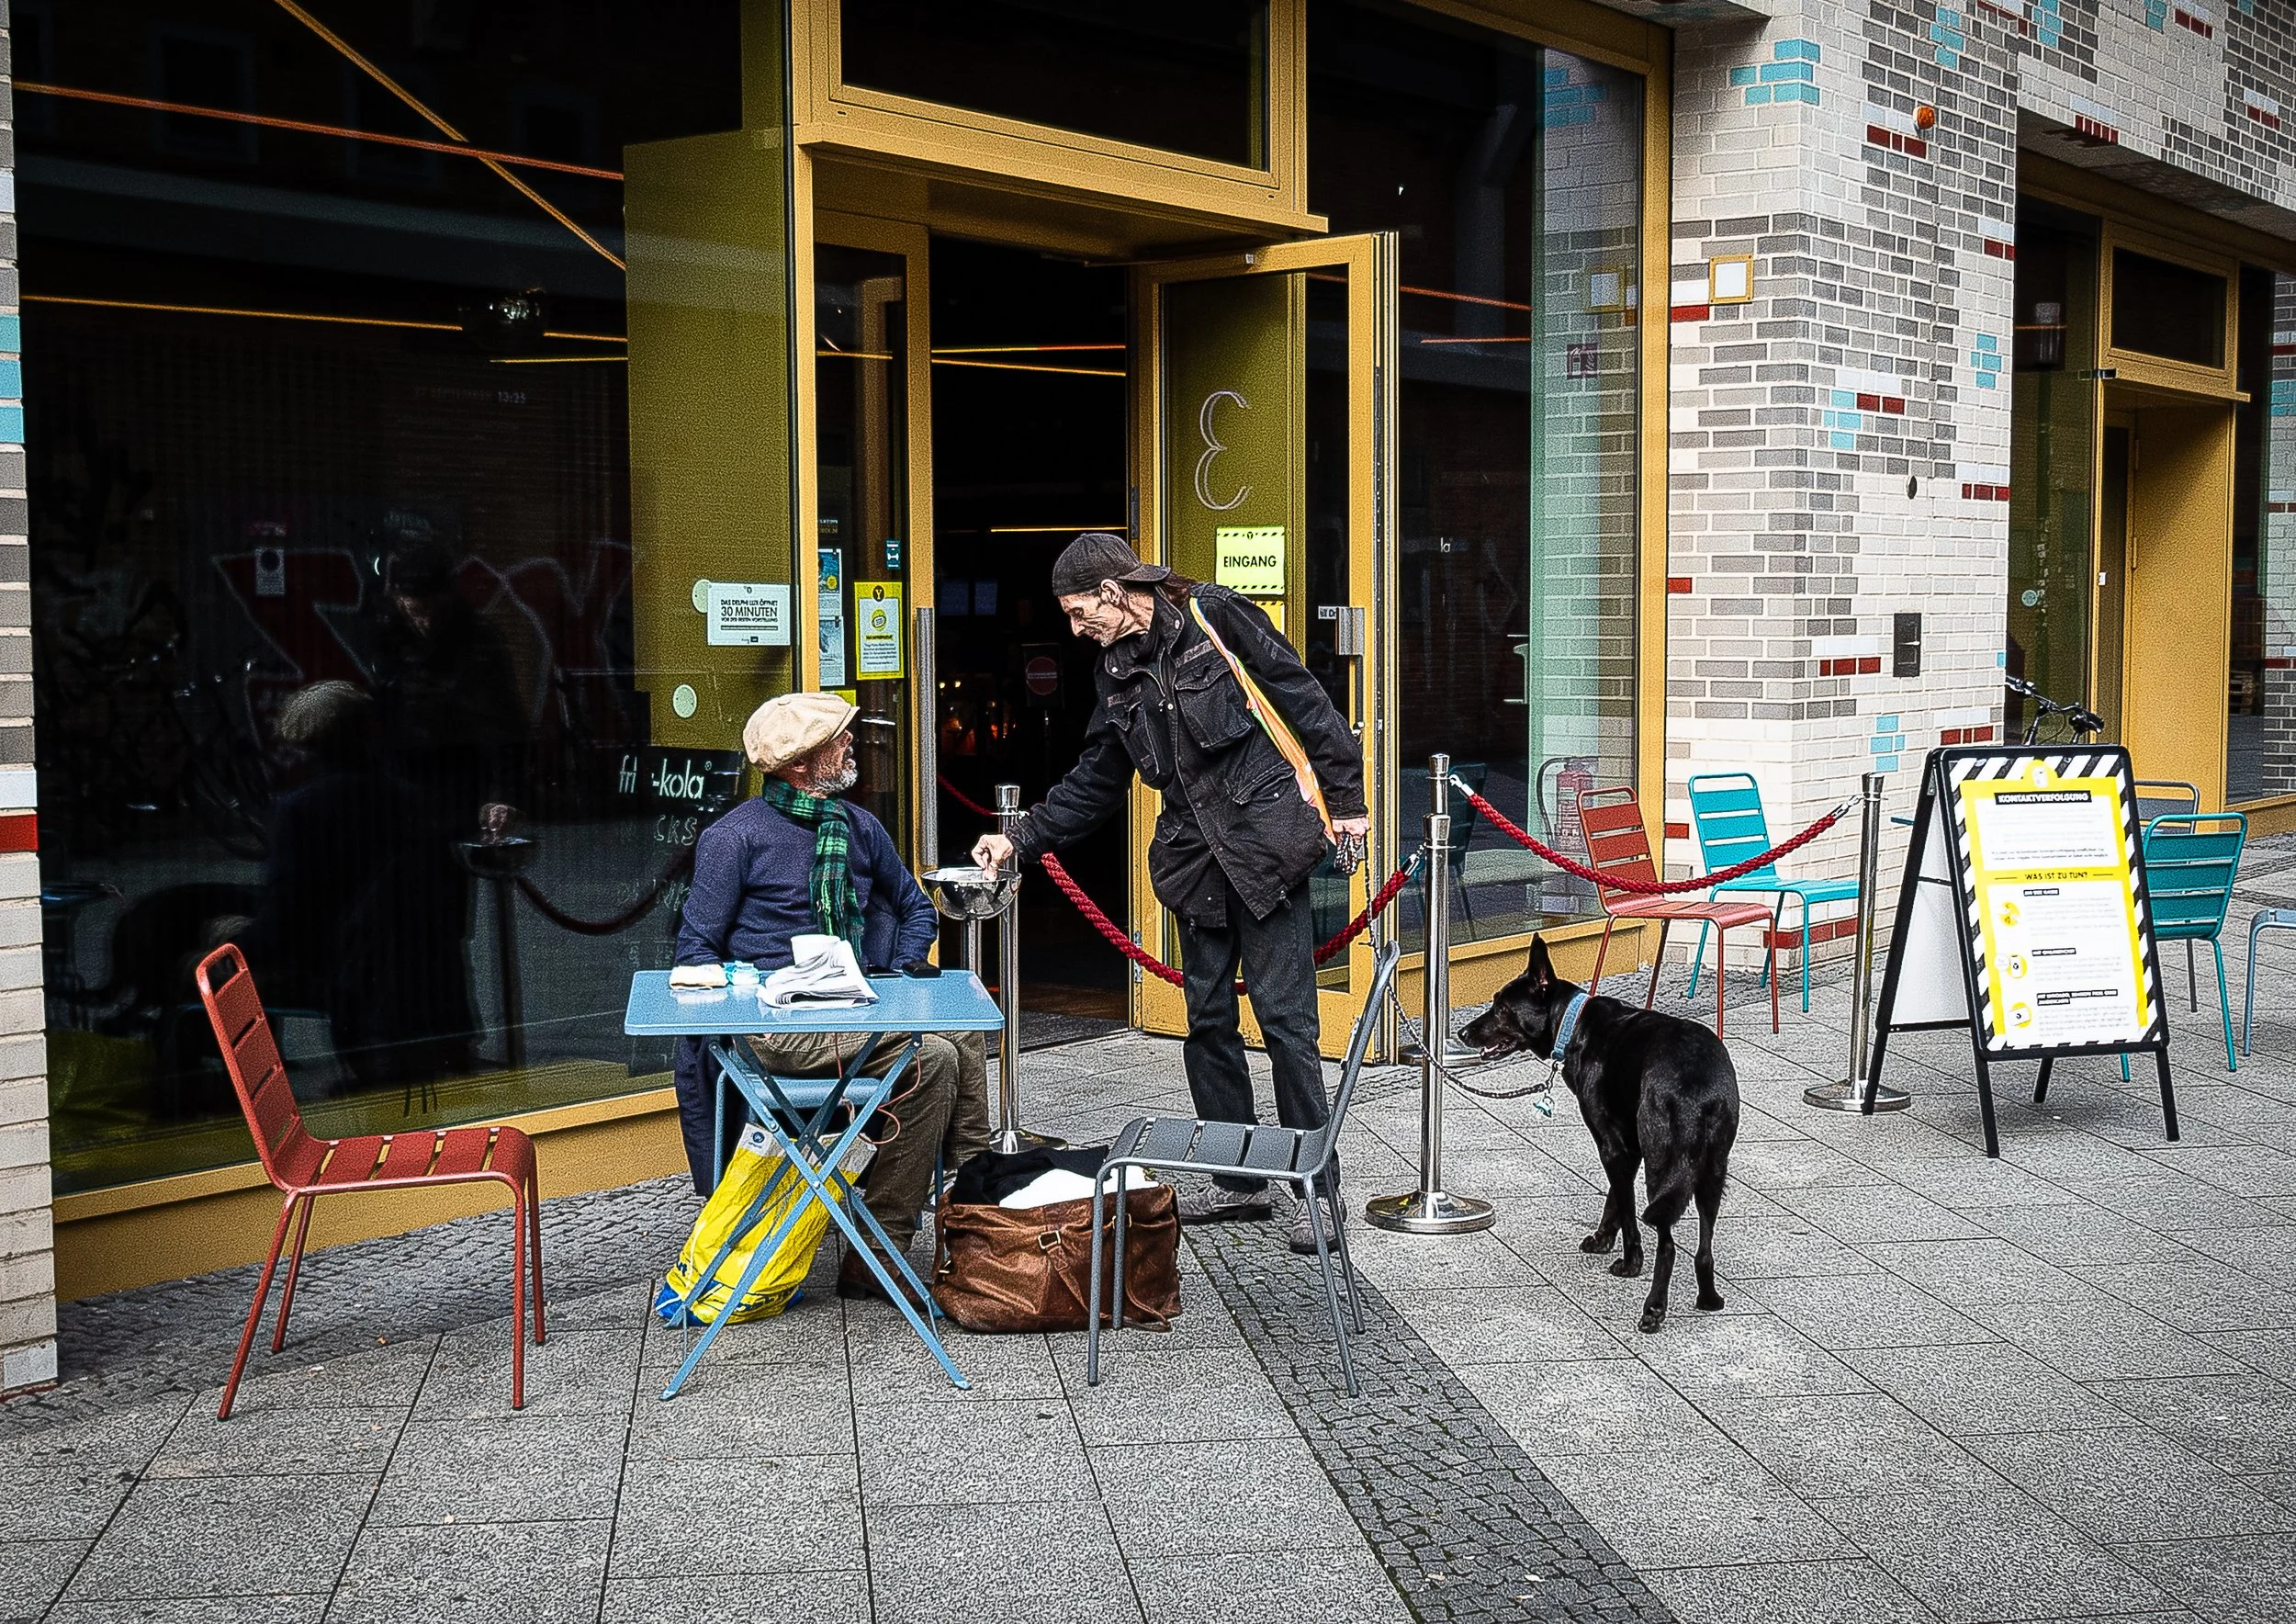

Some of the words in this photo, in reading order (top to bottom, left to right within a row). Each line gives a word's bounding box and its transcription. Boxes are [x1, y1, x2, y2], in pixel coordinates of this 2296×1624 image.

[1223, 555, 1277, 568] EINGANG
[721, 606, 734, 617] 30
[735, 606, 778, 617] MINUTEN
[1998, 792, 2089, 804] KONTAKTVERFOLGUNG
[2044, 872, 2054, 880] IST
[2057, 872, 2067, 880] ZU
[2069, 871, 2088, 879] TUN?
